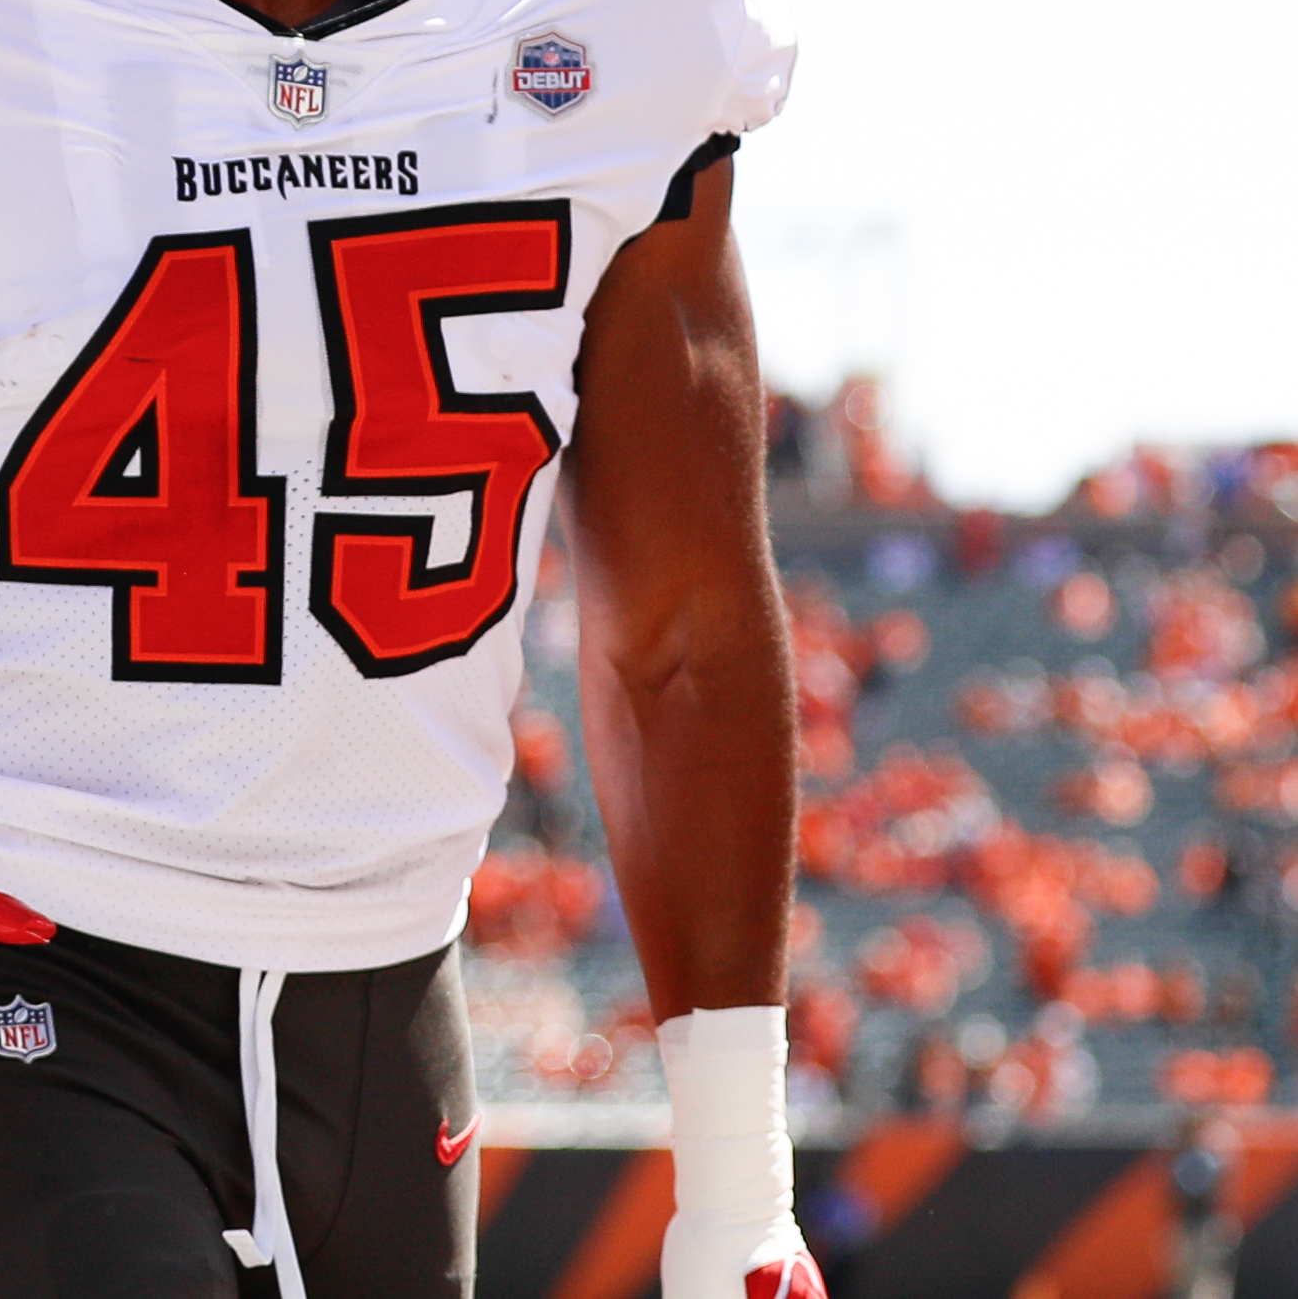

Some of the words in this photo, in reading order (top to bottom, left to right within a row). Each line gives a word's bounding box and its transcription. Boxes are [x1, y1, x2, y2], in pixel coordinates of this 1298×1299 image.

[516, 70, 587, 91] DEBUT
[278, 83, 320, 115] NFL
[171, 151, 419, 202] BUCCANEERS
[2, 1024, 47, 1050] NFL
